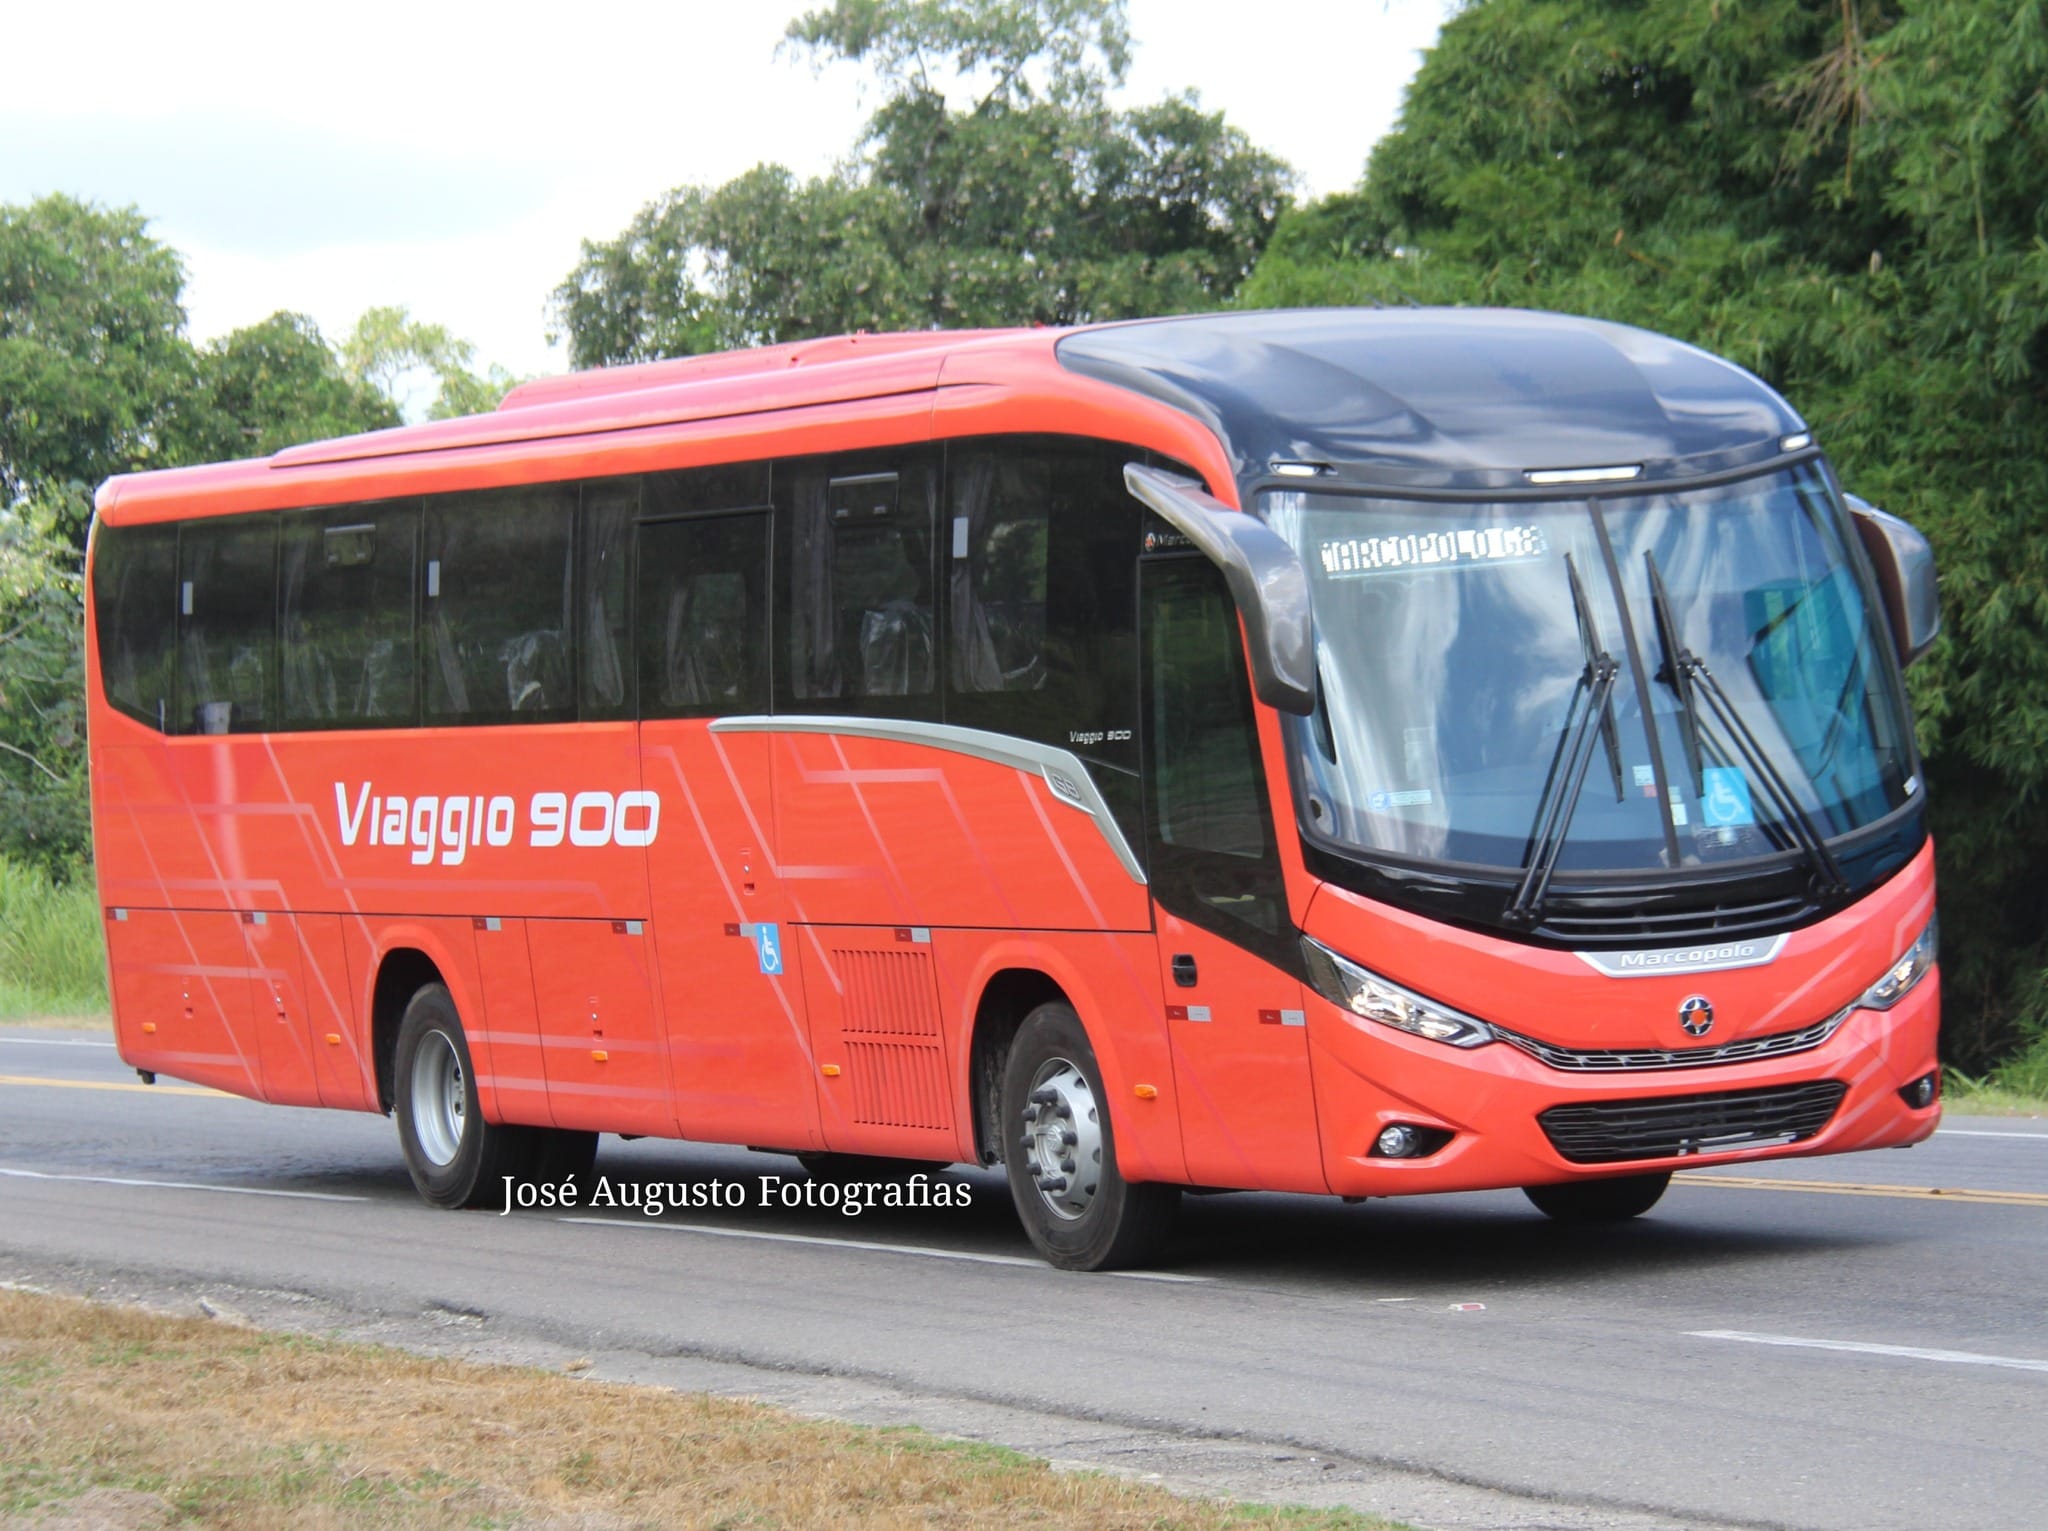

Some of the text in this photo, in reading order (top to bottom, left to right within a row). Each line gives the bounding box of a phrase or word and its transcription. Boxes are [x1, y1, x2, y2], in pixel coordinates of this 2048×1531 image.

[1070, 730, 1132, 745] Viaggio 900
[334, 781, 660, 865] Viaggio 900
[1620, 944, 1753, 967] Marcopolo
